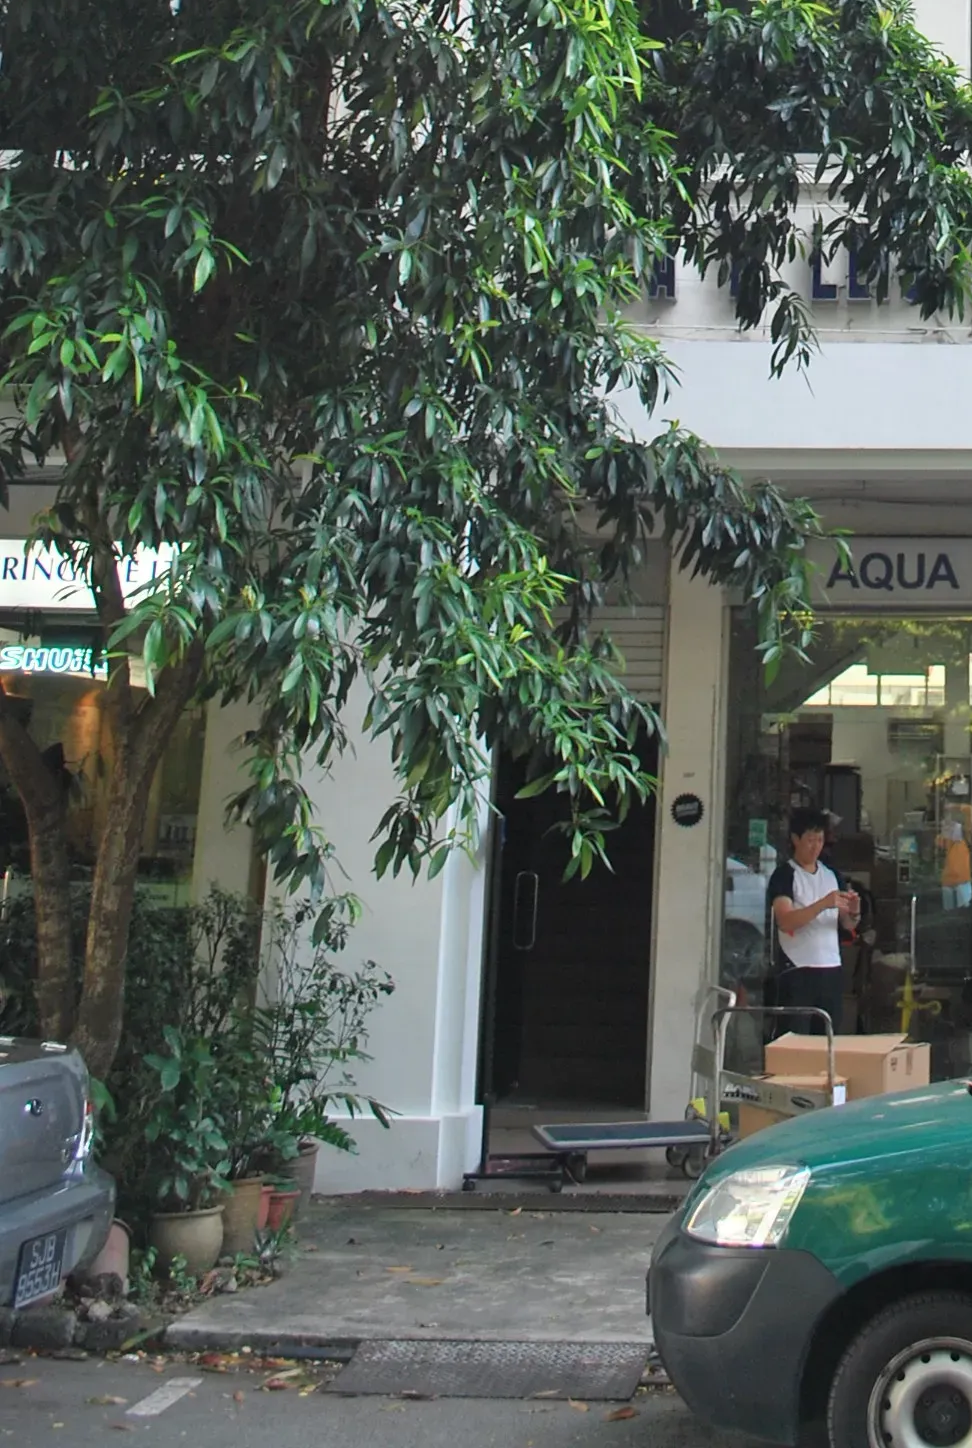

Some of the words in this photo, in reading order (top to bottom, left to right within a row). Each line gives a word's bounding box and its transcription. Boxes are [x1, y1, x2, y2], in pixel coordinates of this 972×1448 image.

[827, 553, 959, 590] AQUA
[30, 1235, 57, 1269] SJB
[16, 1260, 61, 1302] 9553H
